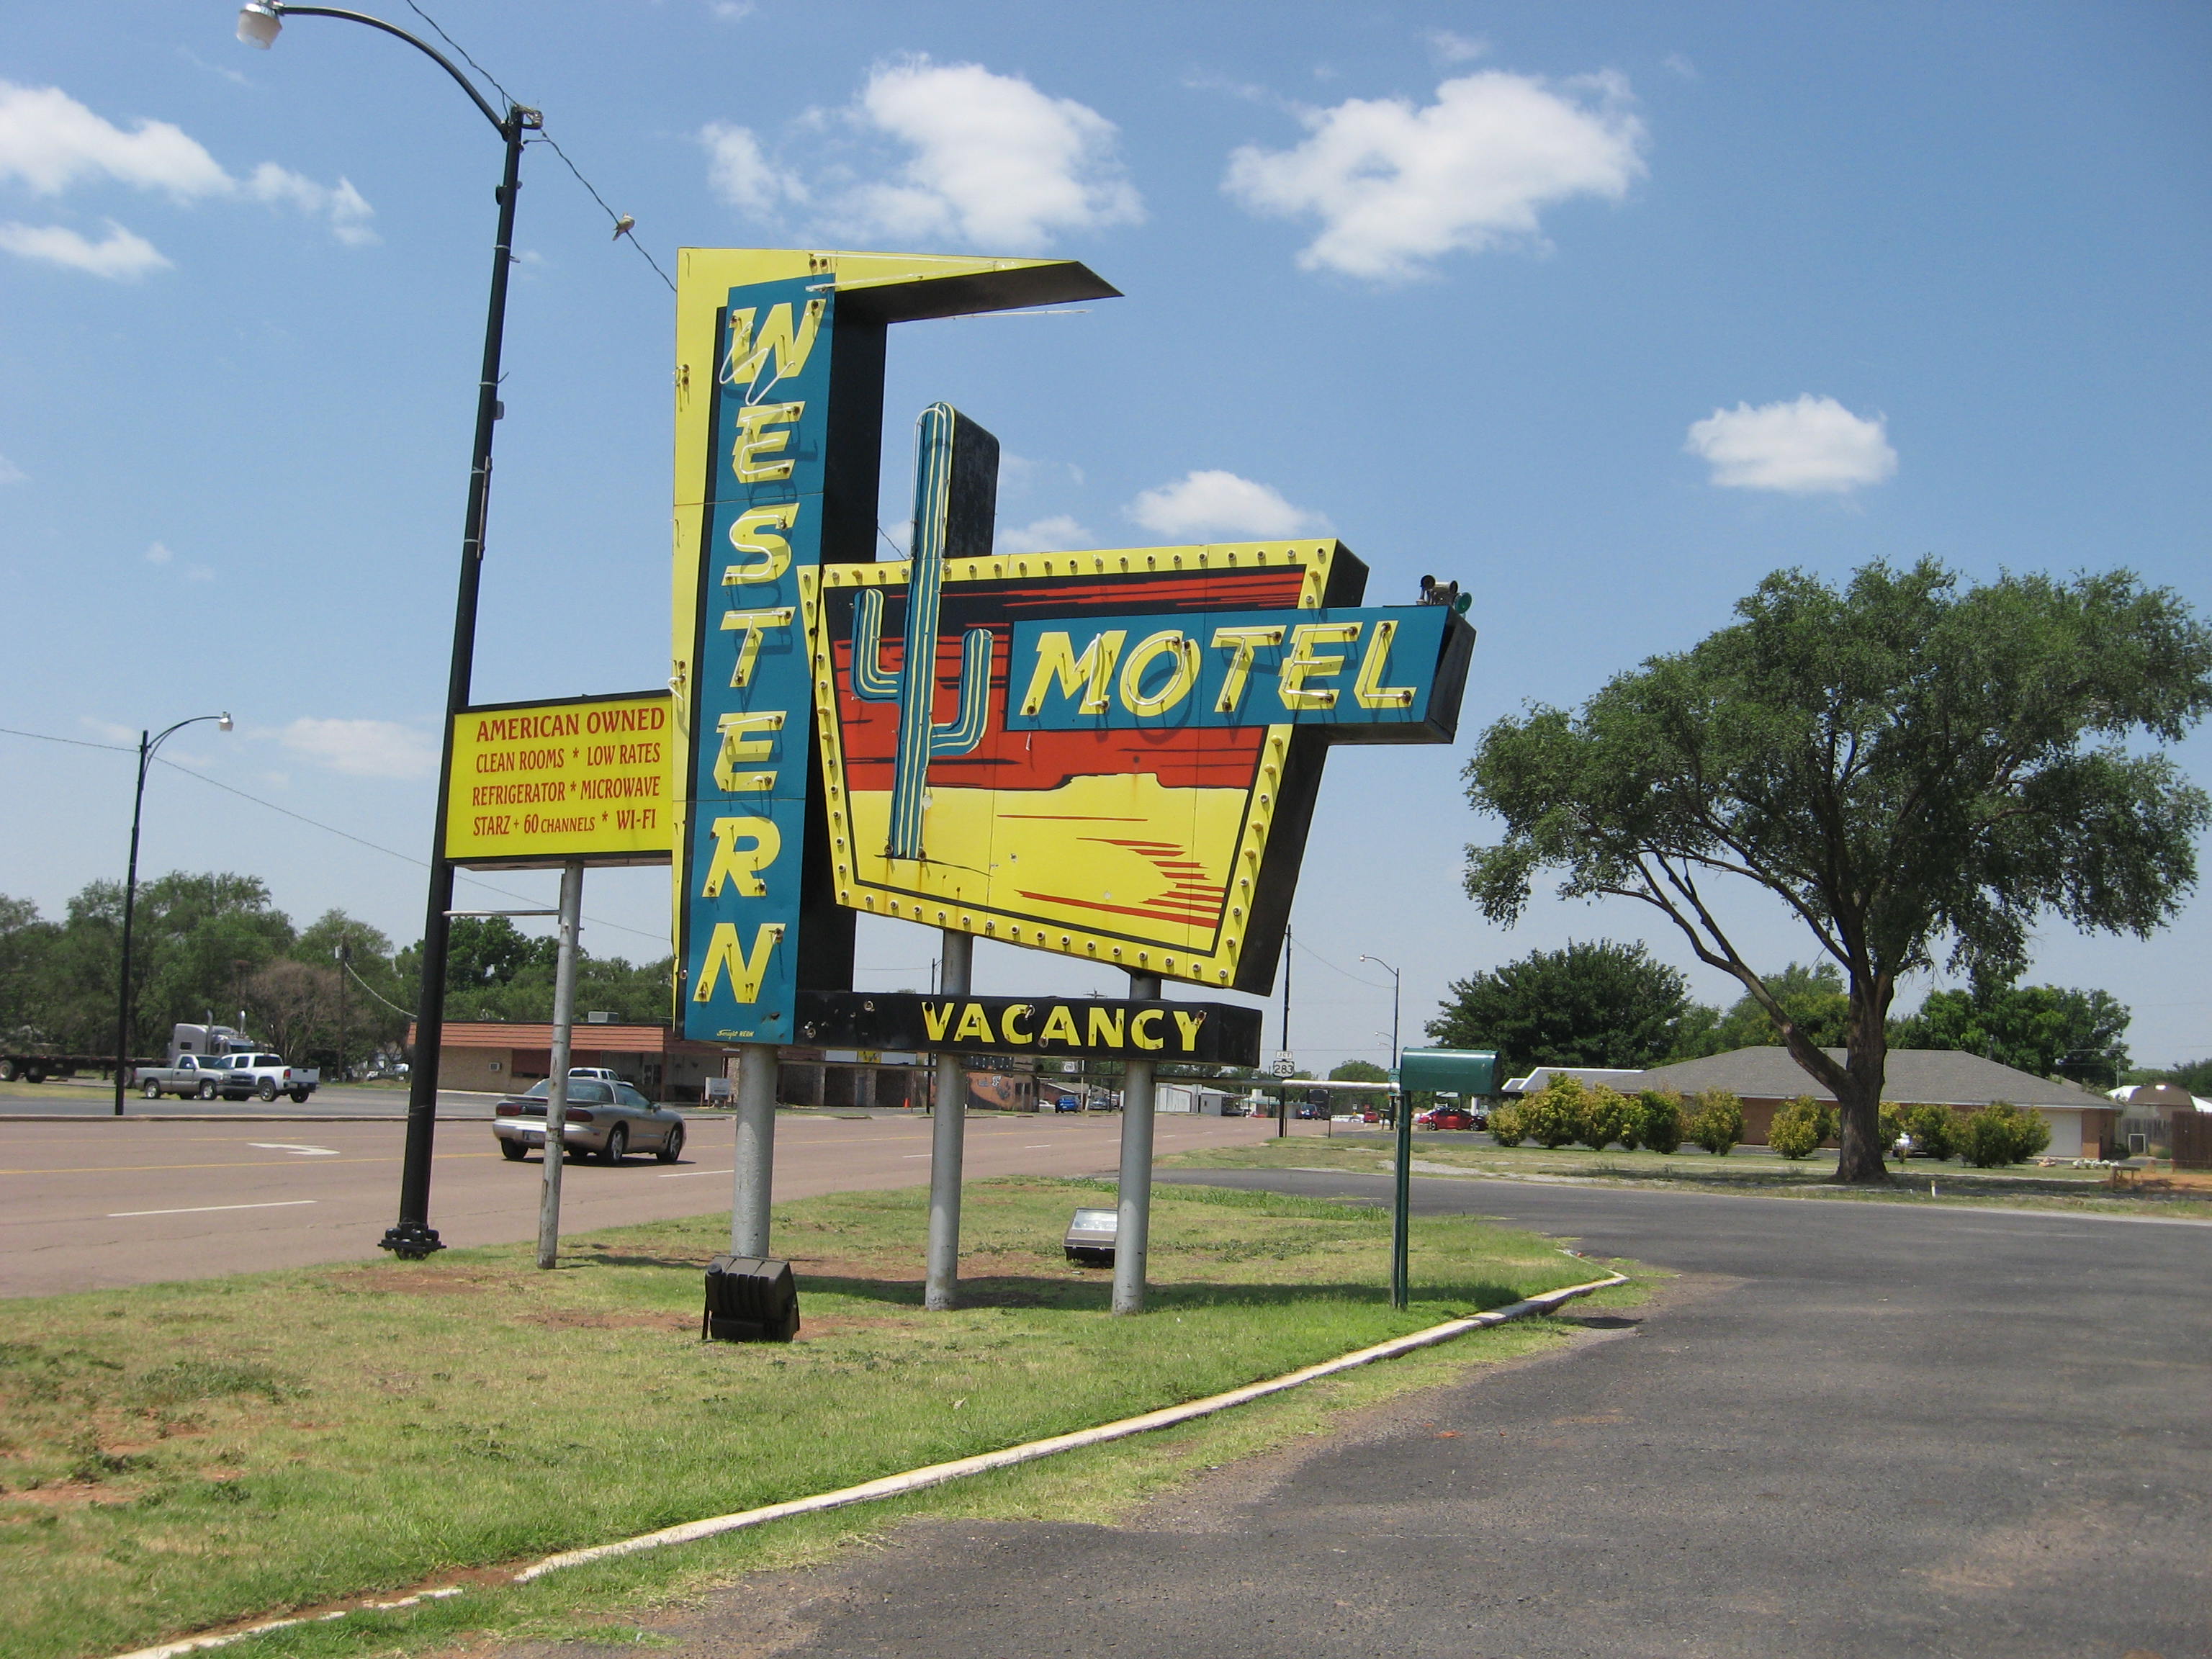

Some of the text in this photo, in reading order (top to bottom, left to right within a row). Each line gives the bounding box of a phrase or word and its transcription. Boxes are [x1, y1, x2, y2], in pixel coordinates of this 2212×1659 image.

[693, 298, 827, 1004] WESTERN
[1020, 620, 1416, 716] MOTEL
[476, 706, 665, 742] AMERICAN OWNED
[475, 742, 661, 774] CLEAN ROOMS LOW RATES
[472, 775, 661, 806] REFRIGERATOR MICROWAVE
[472, 814, 511, 837] STARZ
[523, 814, 539, 834] 60
[541, 817, 596, 834] CHANNELS
[616, 808, 657, 830] WI-FI
[922, 1002, 1206, 1052] VACANCY
[1274, 1065, 1293, 1074] 283
